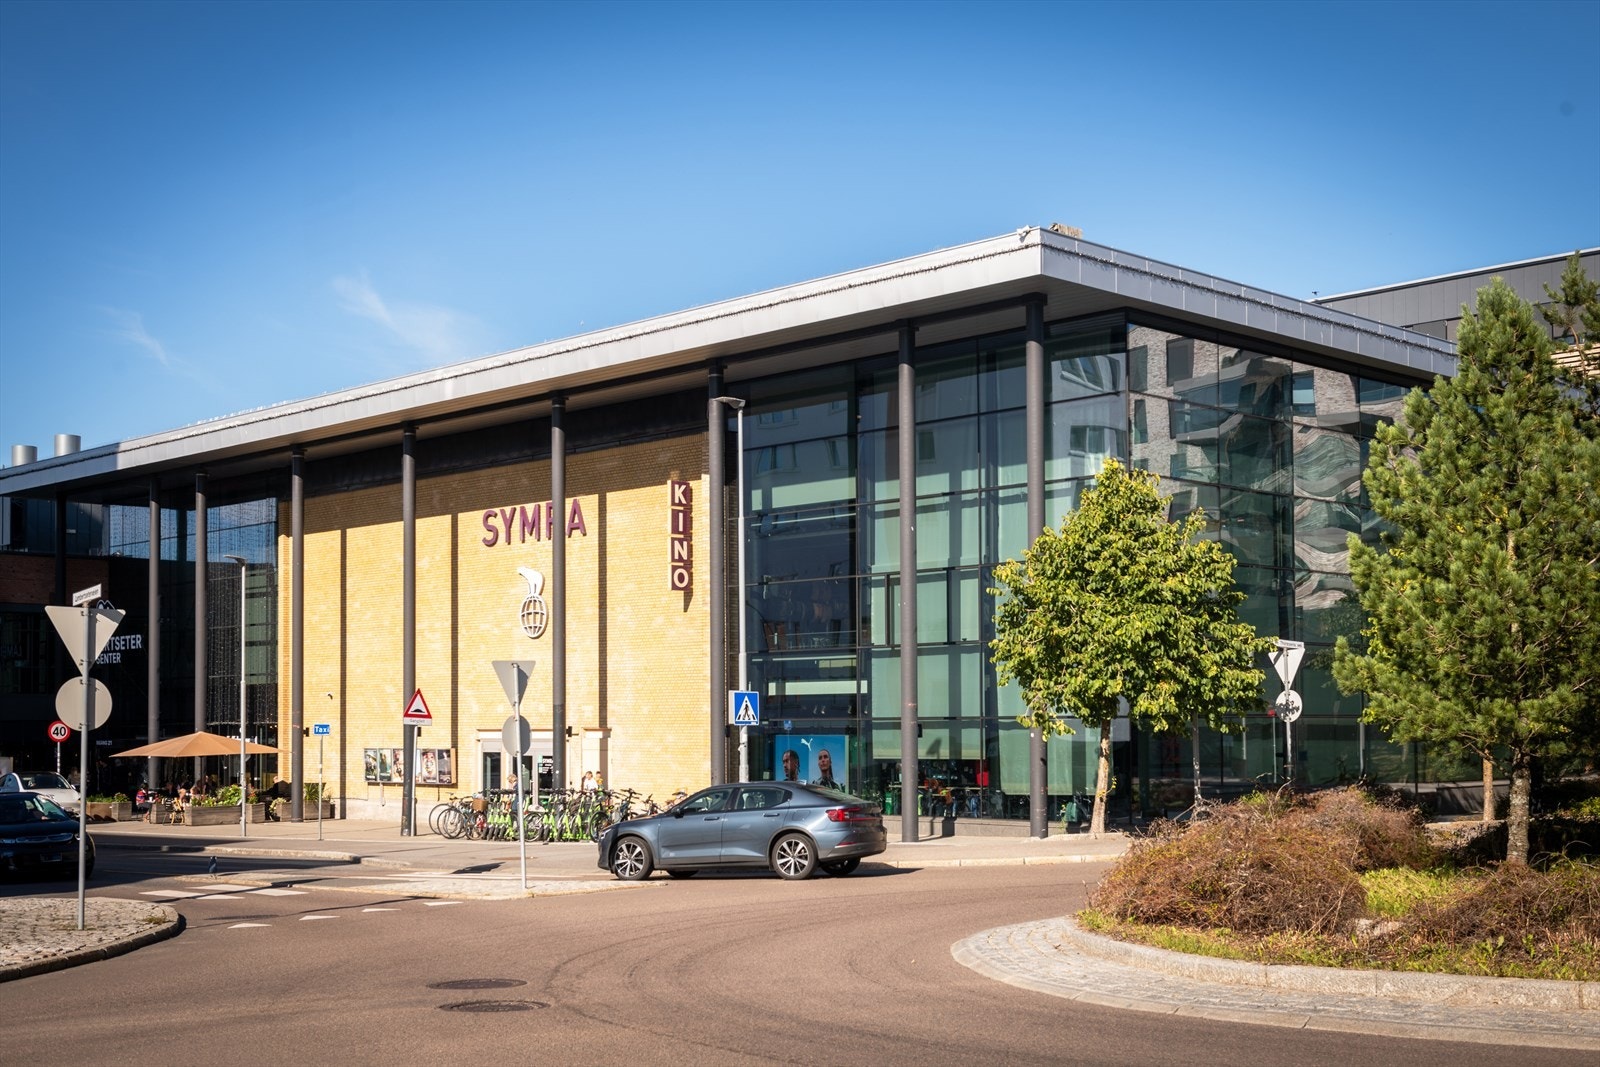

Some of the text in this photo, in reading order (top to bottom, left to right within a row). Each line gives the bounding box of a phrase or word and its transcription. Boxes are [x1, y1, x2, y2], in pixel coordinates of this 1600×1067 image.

[673, 484, 689, 588] KINO
[96, 652, 122, 665] SENTER
[52, 725, 67, 737] 40
[314, 725, 330, 733] Taxi
